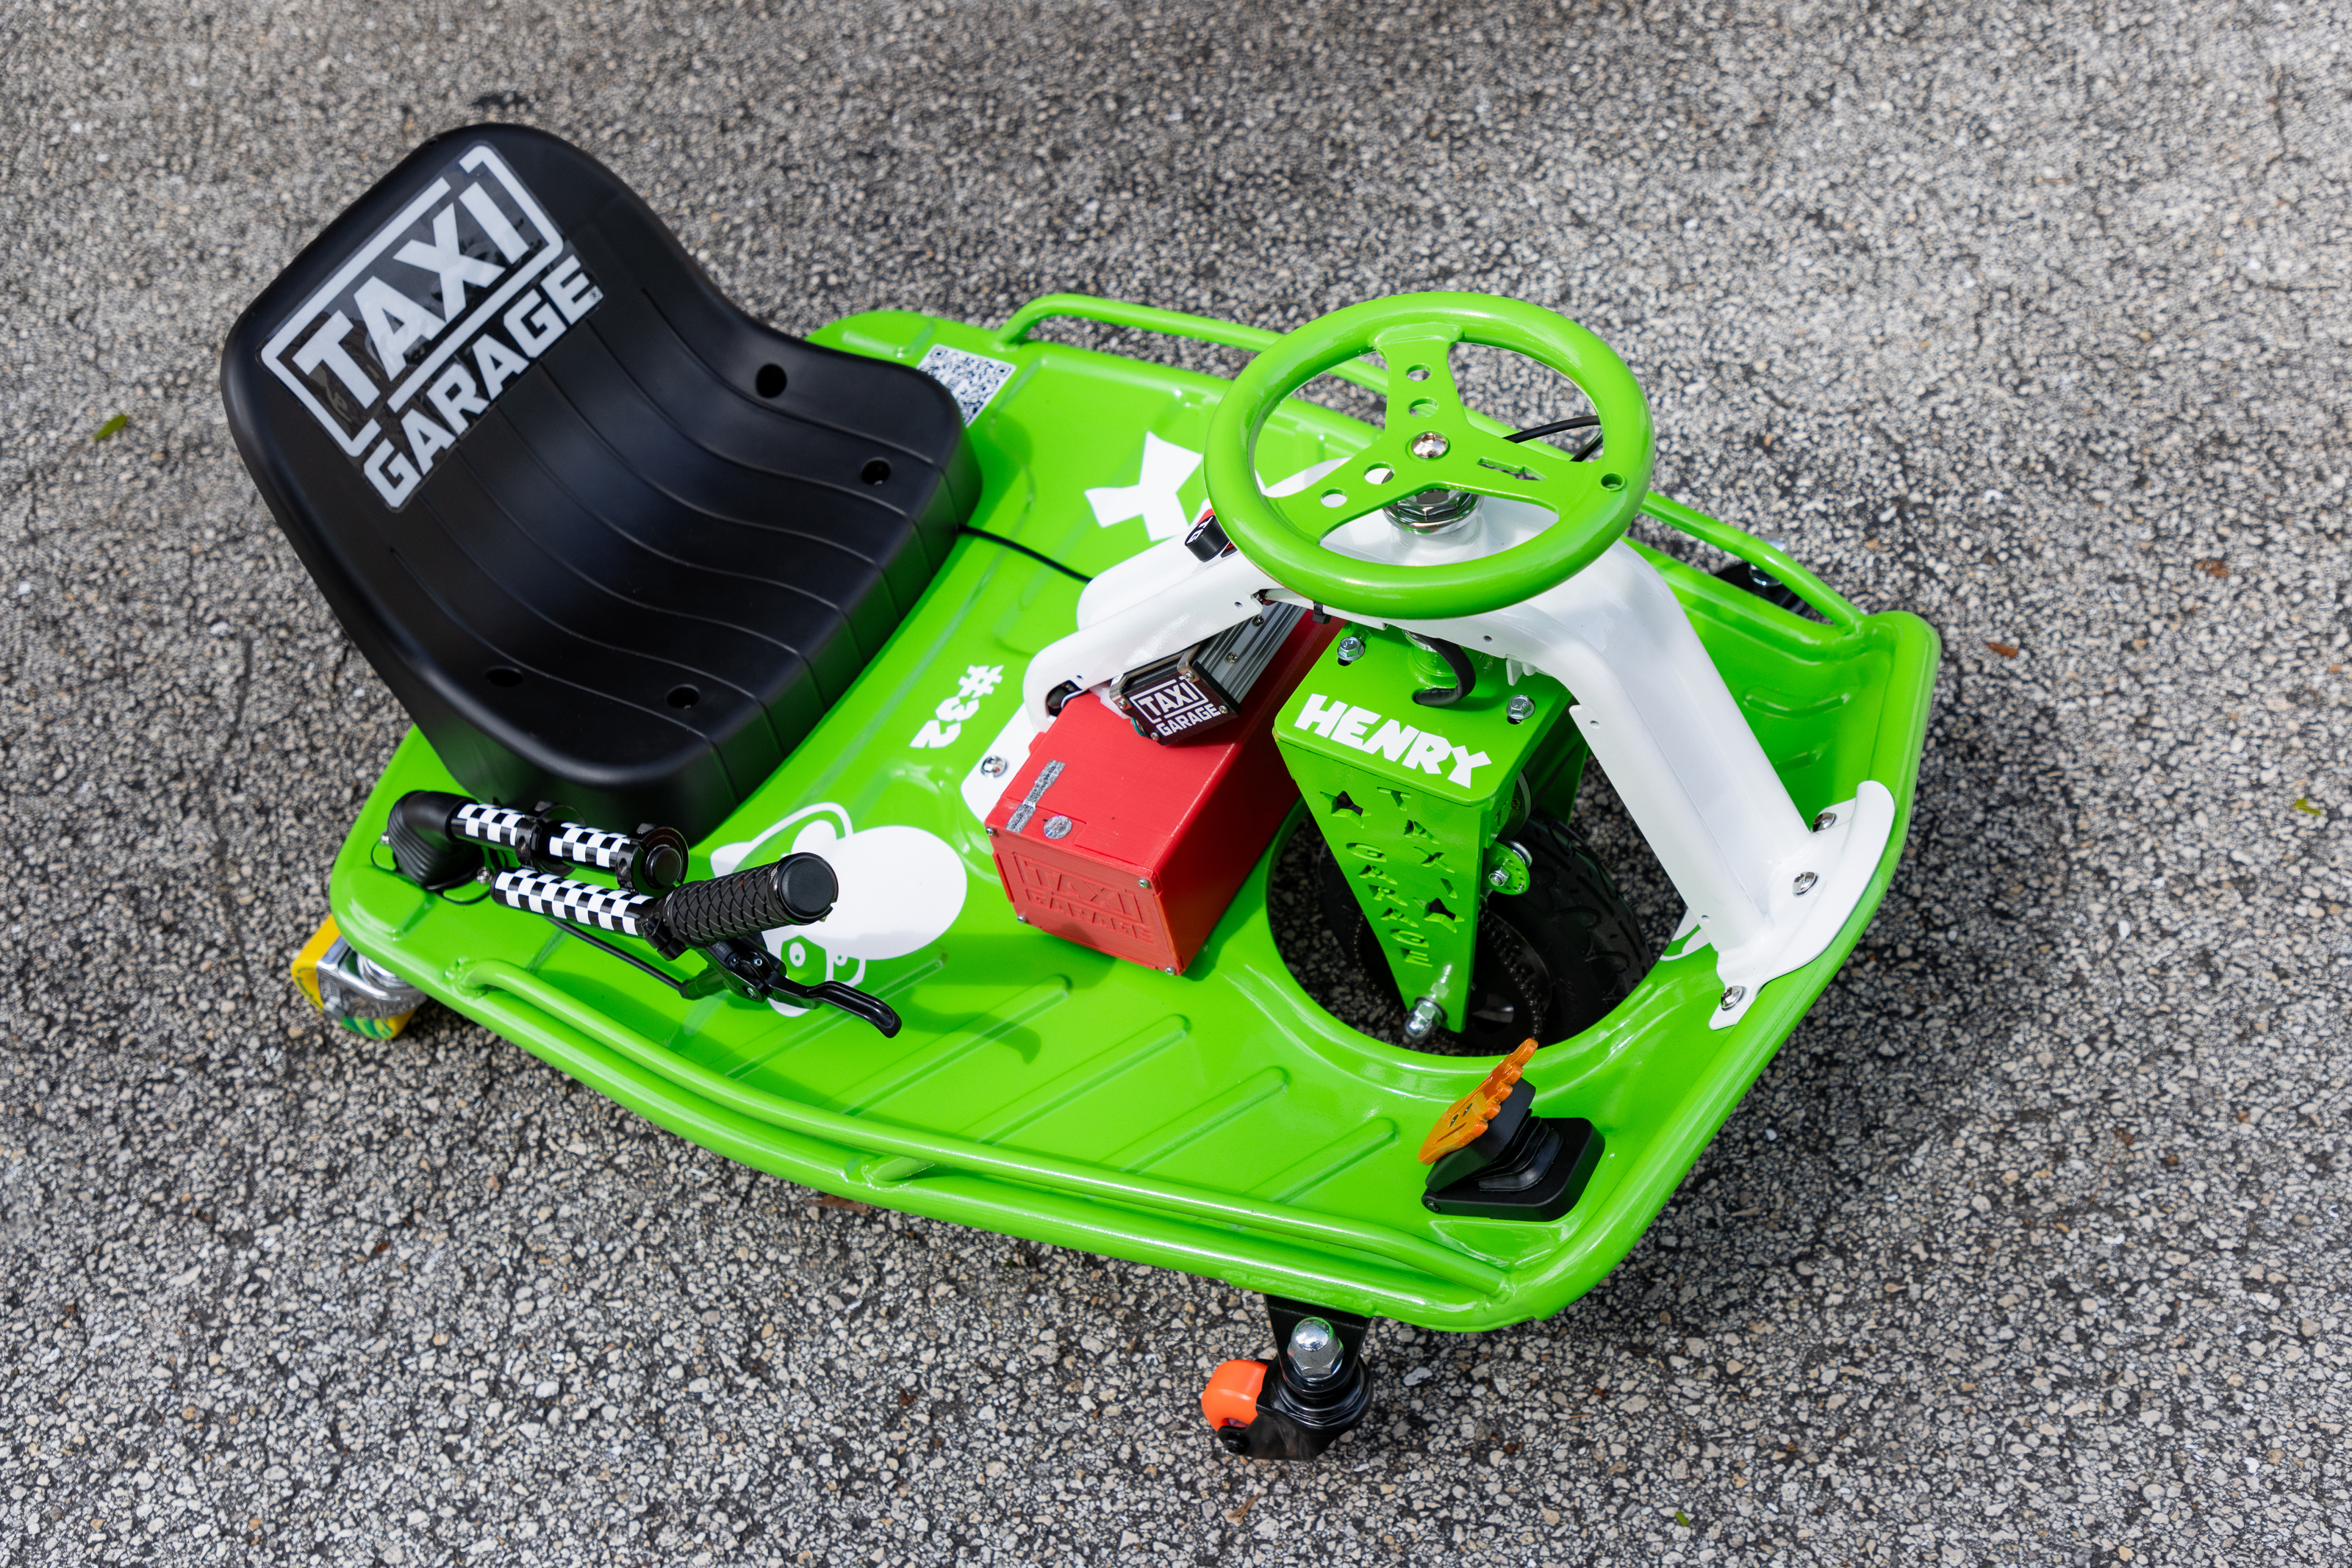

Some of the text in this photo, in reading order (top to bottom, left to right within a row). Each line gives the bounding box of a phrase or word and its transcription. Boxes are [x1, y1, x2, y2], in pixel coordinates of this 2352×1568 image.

[292, 181, 529, 409] TAXI
[363, 254, 598, 508] GARAGE
[1138, 682, 1199, 716] TAXI
[1155, 703, 1221, 736] GARAGE
[1294, 693, 1492, 788] HENRY
[1024, 860, 1133, 918] TAXI
[1025, 888, 1154, 944] GARAGE
